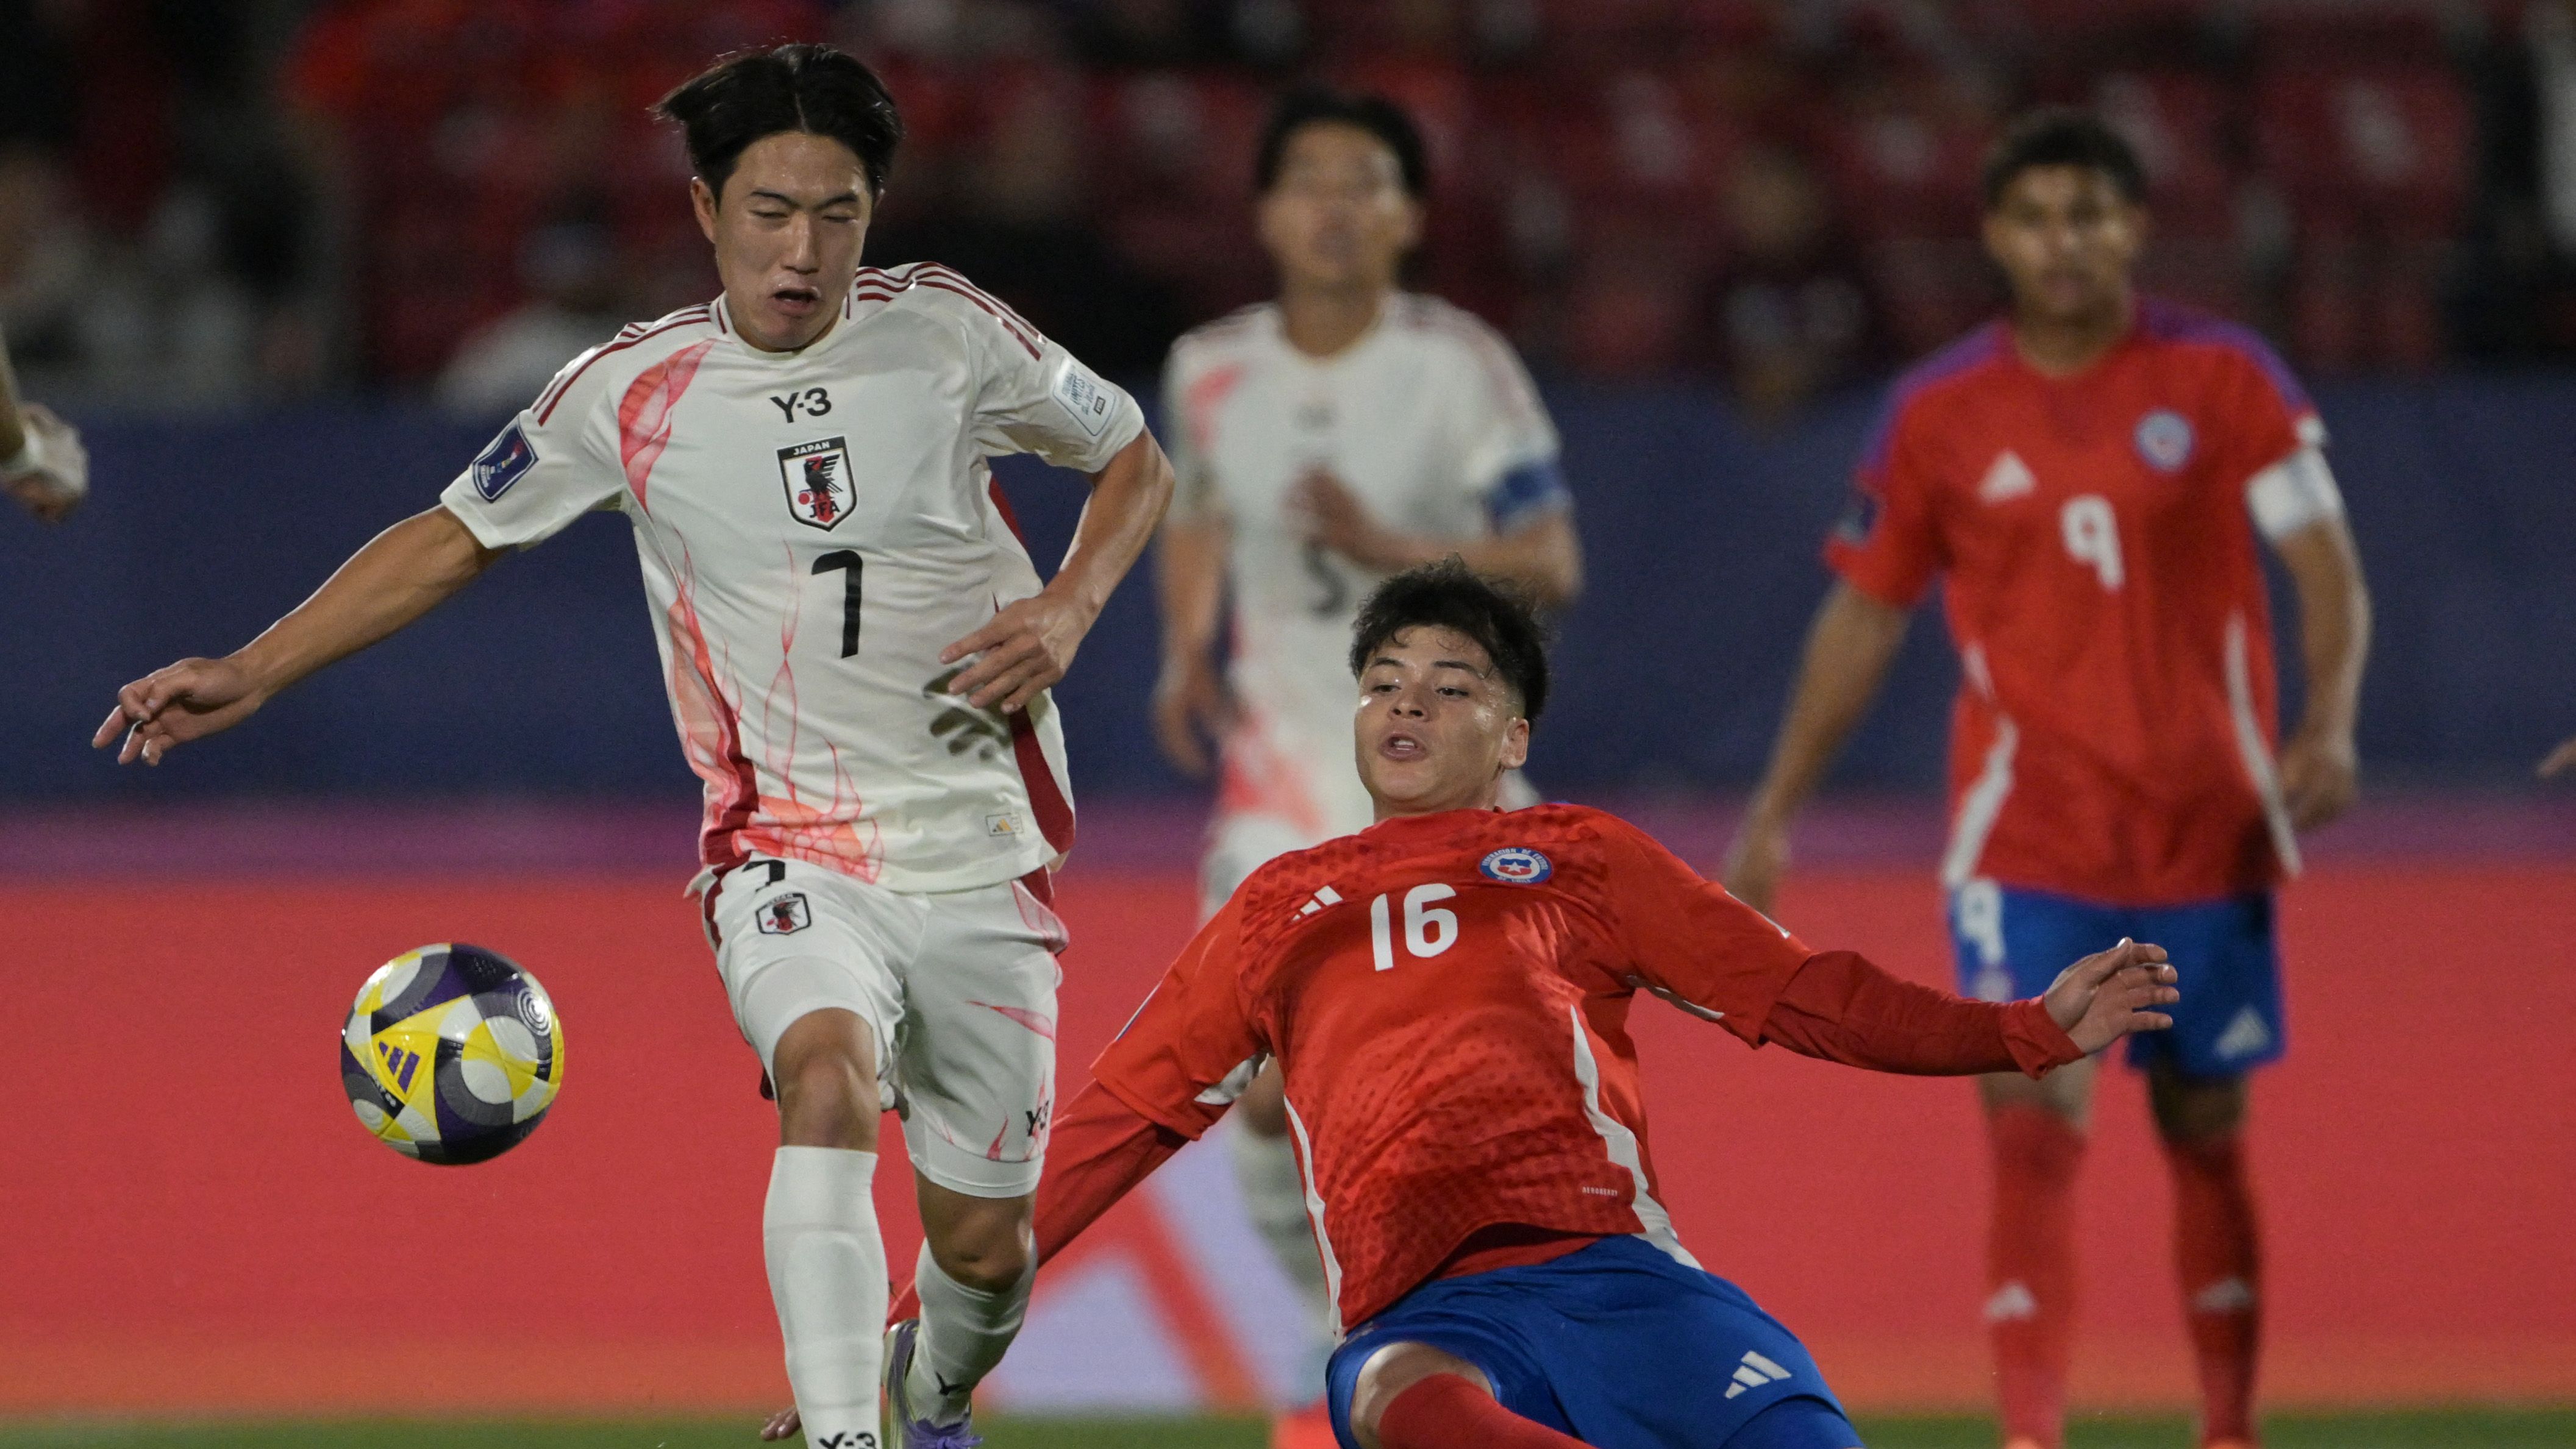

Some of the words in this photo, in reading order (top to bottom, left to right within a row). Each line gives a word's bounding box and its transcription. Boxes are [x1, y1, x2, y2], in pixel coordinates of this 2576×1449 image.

[770, 387, 832, 423] Y-3
[793, 441, 830, 456] JAPAN
[809, 500, 841, 518] JFA
[2060, 495, 2124, 591] 9
[812, 550, 863, 658] 7
[1371, 883, 1458, 971] 16
[1958, 878, 2005, 963] 9
